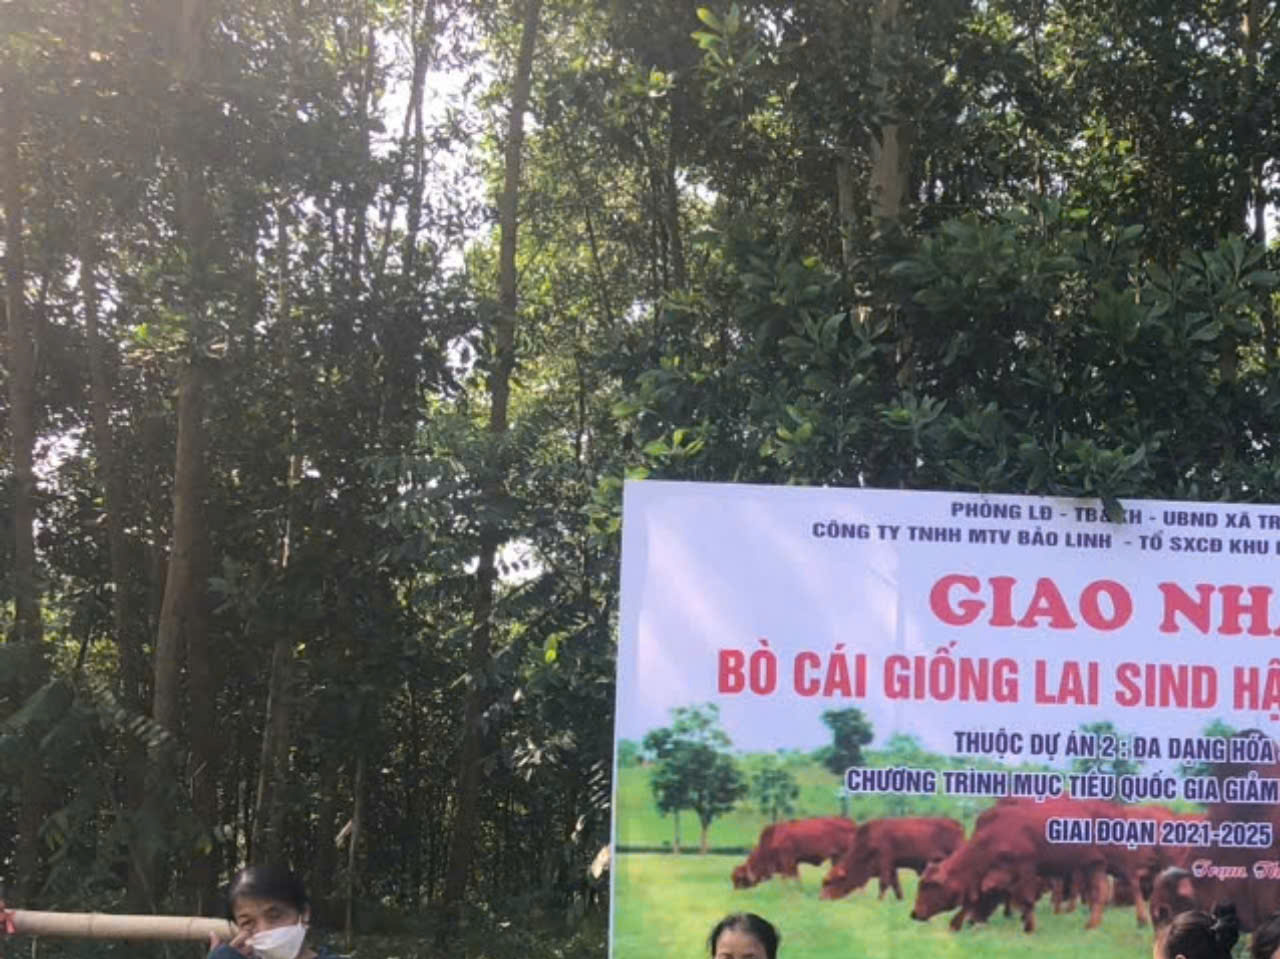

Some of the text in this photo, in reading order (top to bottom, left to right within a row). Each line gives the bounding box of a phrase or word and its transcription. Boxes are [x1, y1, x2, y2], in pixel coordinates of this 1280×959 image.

[951, 499, 1022, 521] PHÒNG
[1029, 505, 1053, 521] LĐ
[1075, 507, 1142, 524] TB&H
[1163, 511, 1218, 528] UBND
[1224, 510, 1251, 529] XÃ
[812, 520, 870, 540] CÔNG
[877, 524, 900, 541] TY
[907, 525, 962, 543] TNHH
[968, 527, 1011, 546] MTV
[1017, 525, 1058, 547] BẢO
[1065, 532, 1113, 550] LINH
[1139, 530, 1163, 551] TỔ
[1169, 536, 1222, 553] SXCĐ
[1229, 538, 1269, 555] KHU
[929, 573, 1134, 631] GIAO
[718, 639, 777, 696] BÒ
[793, 643, 867, 698] CÁI
[884, 641, 1019, 704] GIỐNG
[1035, 660, 1099, 706] LAI
[1115, 662, 1218, 709] SIND
[954, 729, 1024, 759] THUỘC
[1030, 732, 1060, 761] DỰ
[1065, 730, 1096, 758] ÁN
[1101, 736, 1115, 758] 2
[1133, 736, 1163, 760] ĐA
[1169, 737, 1225, 766] DẠNG
[847, 768, 936, 793] CHƯƠNG
[944, 767, 1006, 796] TRÌNH
[1013, 773, 1062, 801] MỤC
[1069, 769, 1114, 798] TIÊU
[1121, 770, 1177, 800] QUỐC
[1184, 777, 1218, 801] GIA
[1225, 772, 1280, 802] GIẢM
[1048, 819, 1272, 848] GIAI ĐOẠN 2021-2025
